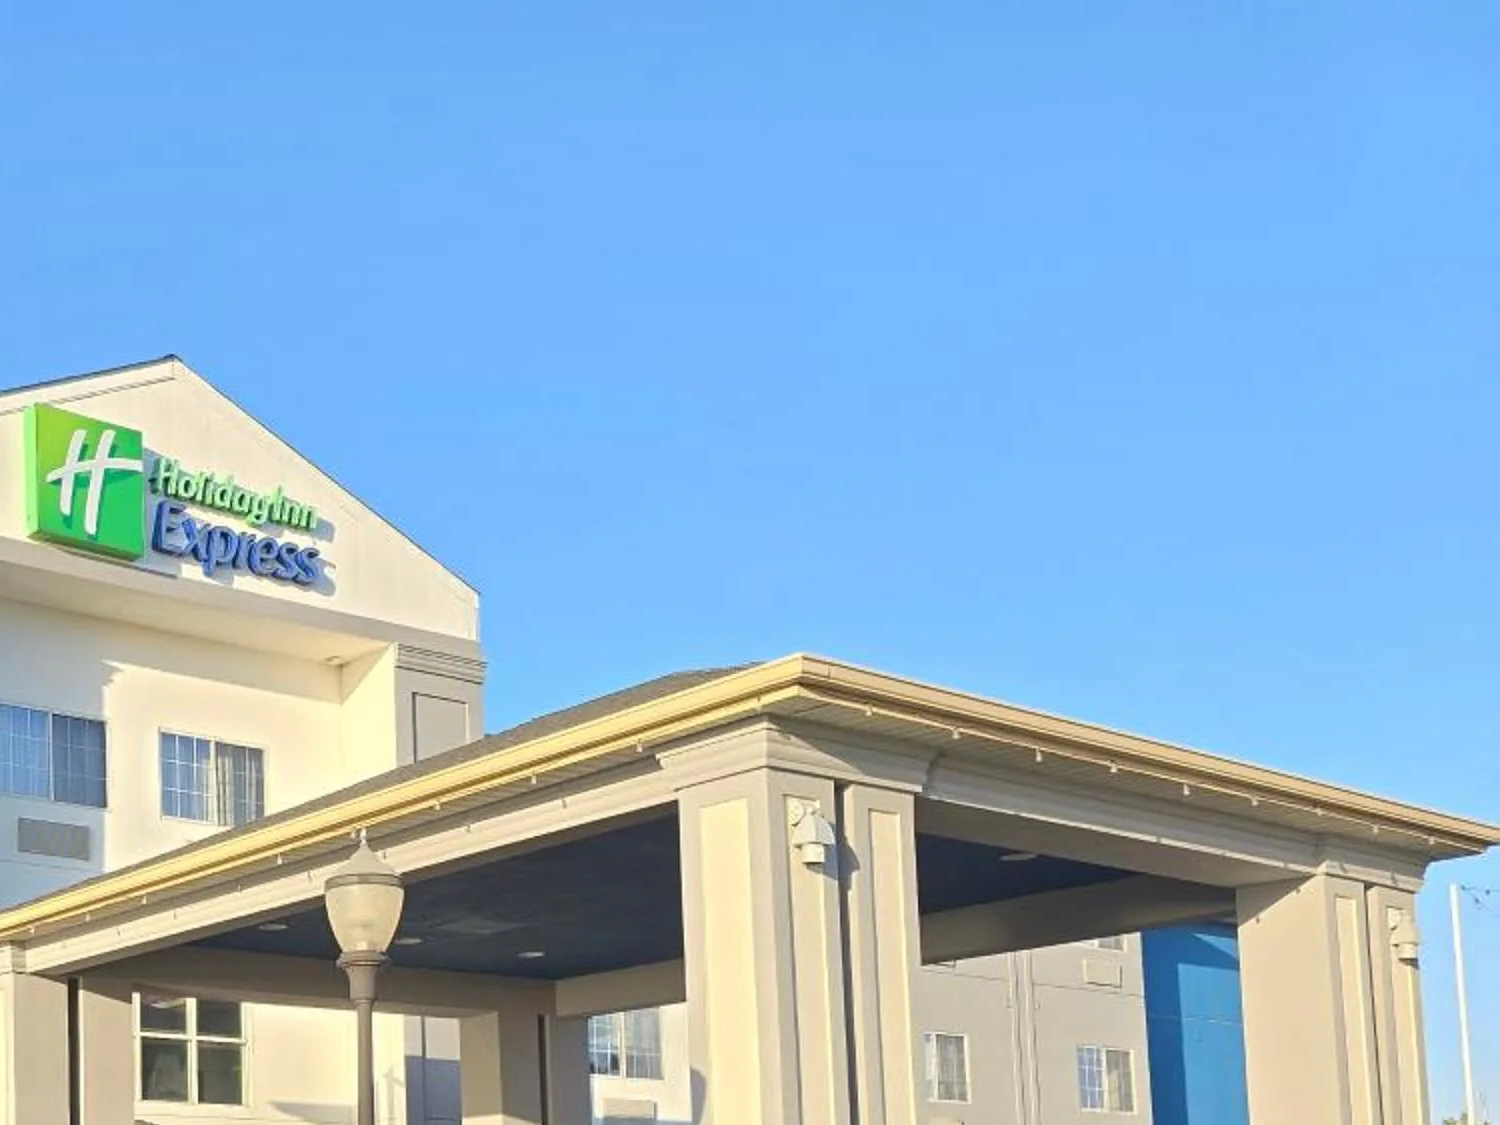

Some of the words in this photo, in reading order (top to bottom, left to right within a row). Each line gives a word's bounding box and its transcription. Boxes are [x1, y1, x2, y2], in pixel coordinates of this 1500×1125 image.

[156, 457, 269, 527] Holiday
[268, 484, 318, 530] Inn
[151, 499, 320, 585] Express
